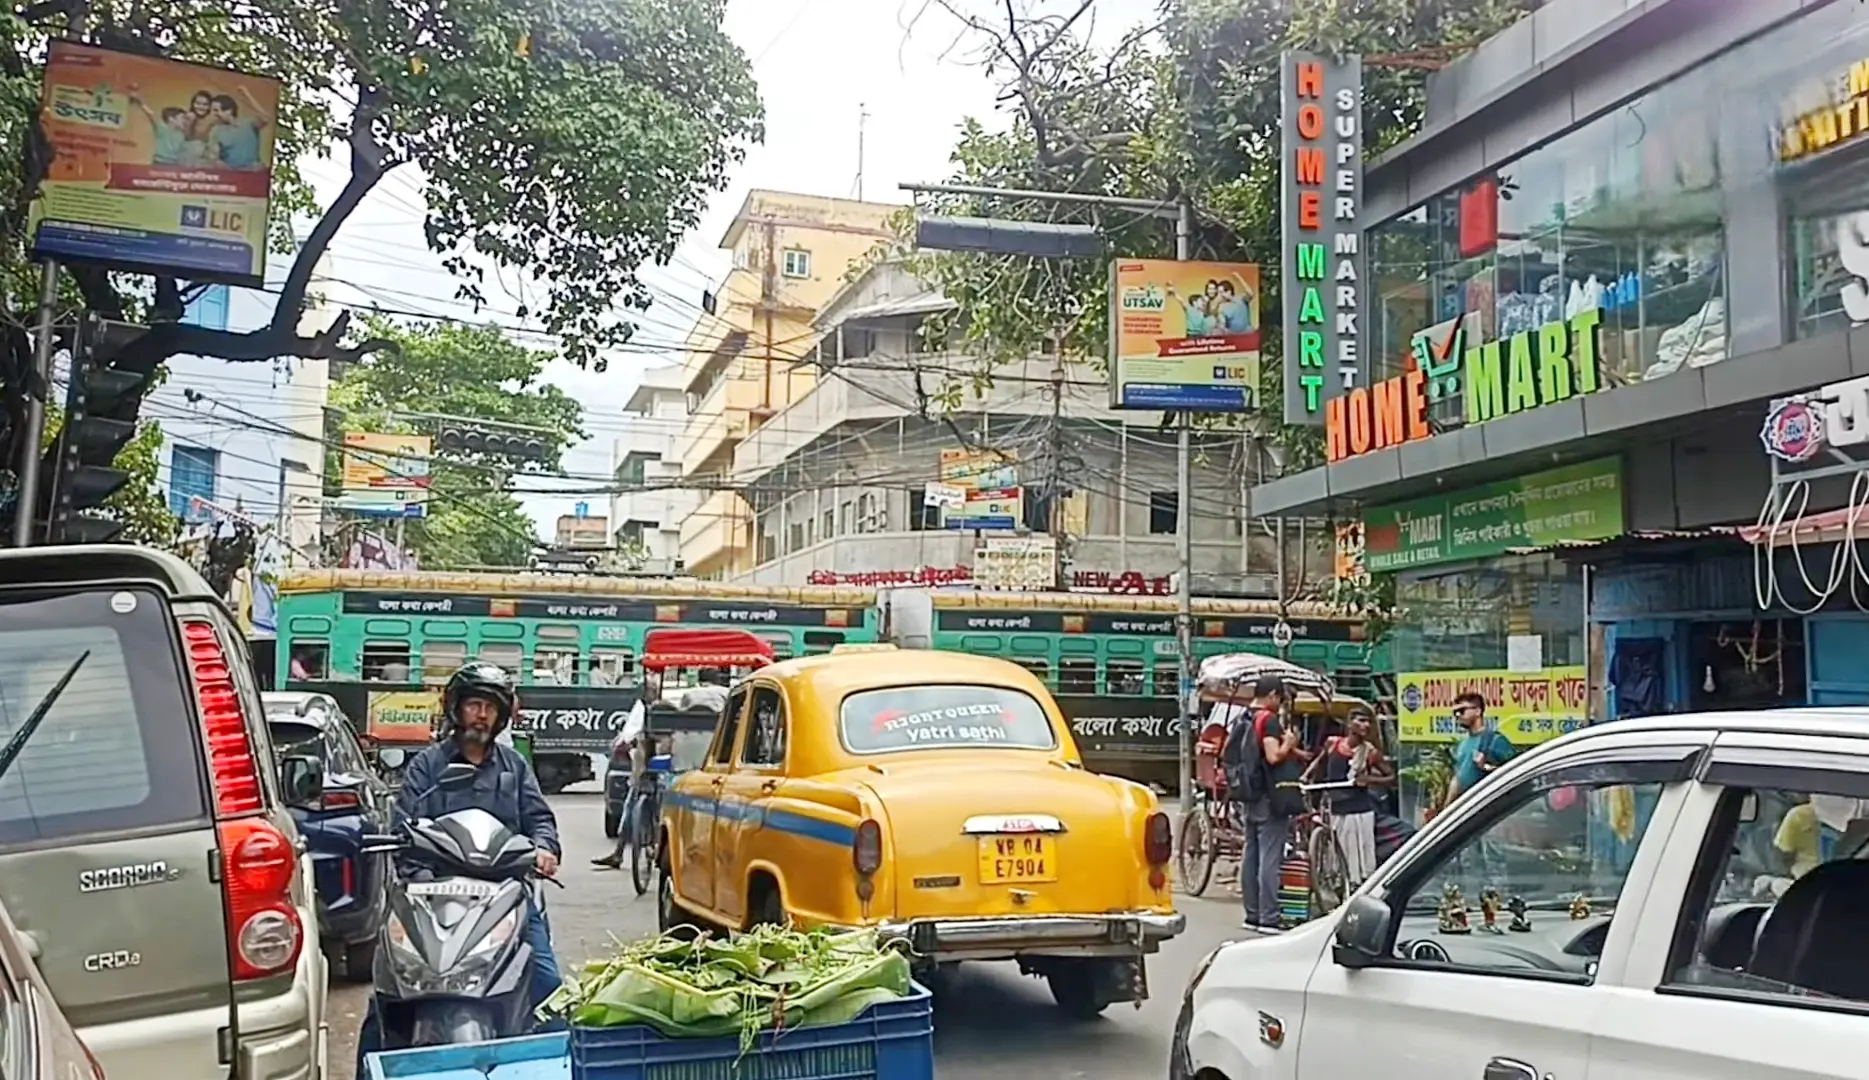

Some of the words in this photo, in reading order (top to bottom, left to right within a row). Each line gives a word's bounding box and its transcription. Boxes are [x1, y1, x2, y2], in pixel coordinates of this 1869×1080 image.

[1296, 62, 1325, 229] HOME
[1335, 88, 1356, 221] SUPER
[211, 210, 243, 231] LIC
[1124, 298, 1163, 308] UTSAV
[1334, 233, 1358, 389] MARKET
[1296, 243, 1325, 412] MART
[1168, 346, 1208, 355] Guaranteed
[1196, 338, 1225, 346] Lifetime
[1228, 368, 1245, 379] LIC
[1326, 368, 1430, 462] HOME
[1466, 308, 1604, 425] MART
[1410, 514, 1443, 545] MART
[1393, 551, 1409, 565] SALE
[1417, 546, 1440, 561] RETAIL
[1073, 571, 1110, 587] NEW
[1424, 678, 1454, 708] ABDUL
[555, 707, 604, 730] কথা
[1121, 714, 1163, 736] কথা
[906, 725, 955, 742] yatri
[959, 725, 1006, 740] sathi
[995, 838, 1016, 855] WB
[1024, 837, 1042, 854] 04
[79, 860, 167, 893] SCORPIO
[995, 858, 1045, 878] E7904
